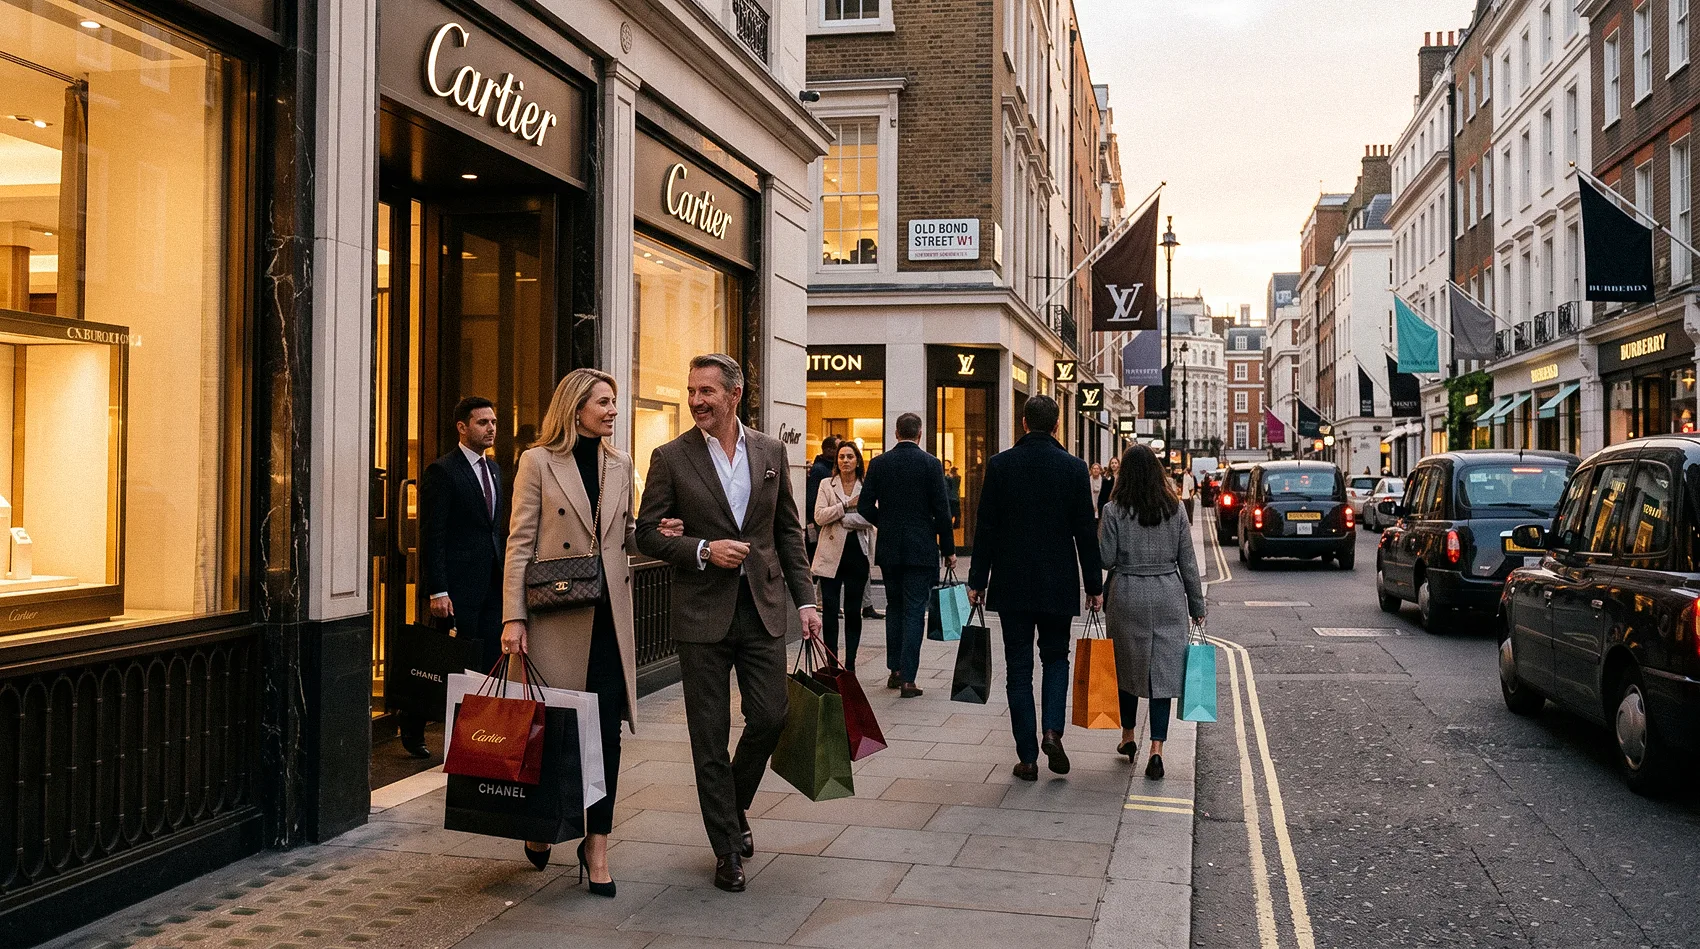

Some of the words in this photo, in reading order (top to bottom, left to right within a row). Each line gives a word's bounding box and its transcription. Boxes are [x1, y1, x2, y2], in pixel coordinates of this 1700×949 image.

[426, 22, 557, 147] Cartier
[666, 162, 733, 240] Cartier
[914, 223, 936, 235] OLD
[939, 223, 968, 234] BOND
[914, 236, 955, 247] STREET
[957, 235, 973, 246] W1
[1620, 333, 1666, 361] BURBERRY
[779, 422, 801, 445] Cartier
[9, 609, 39, 621] Cartier
[410, 668, 443, 683] CHANEL
[471, 729, 507, 744] Cartier
[478, 783, 526, 799] CHANEL
